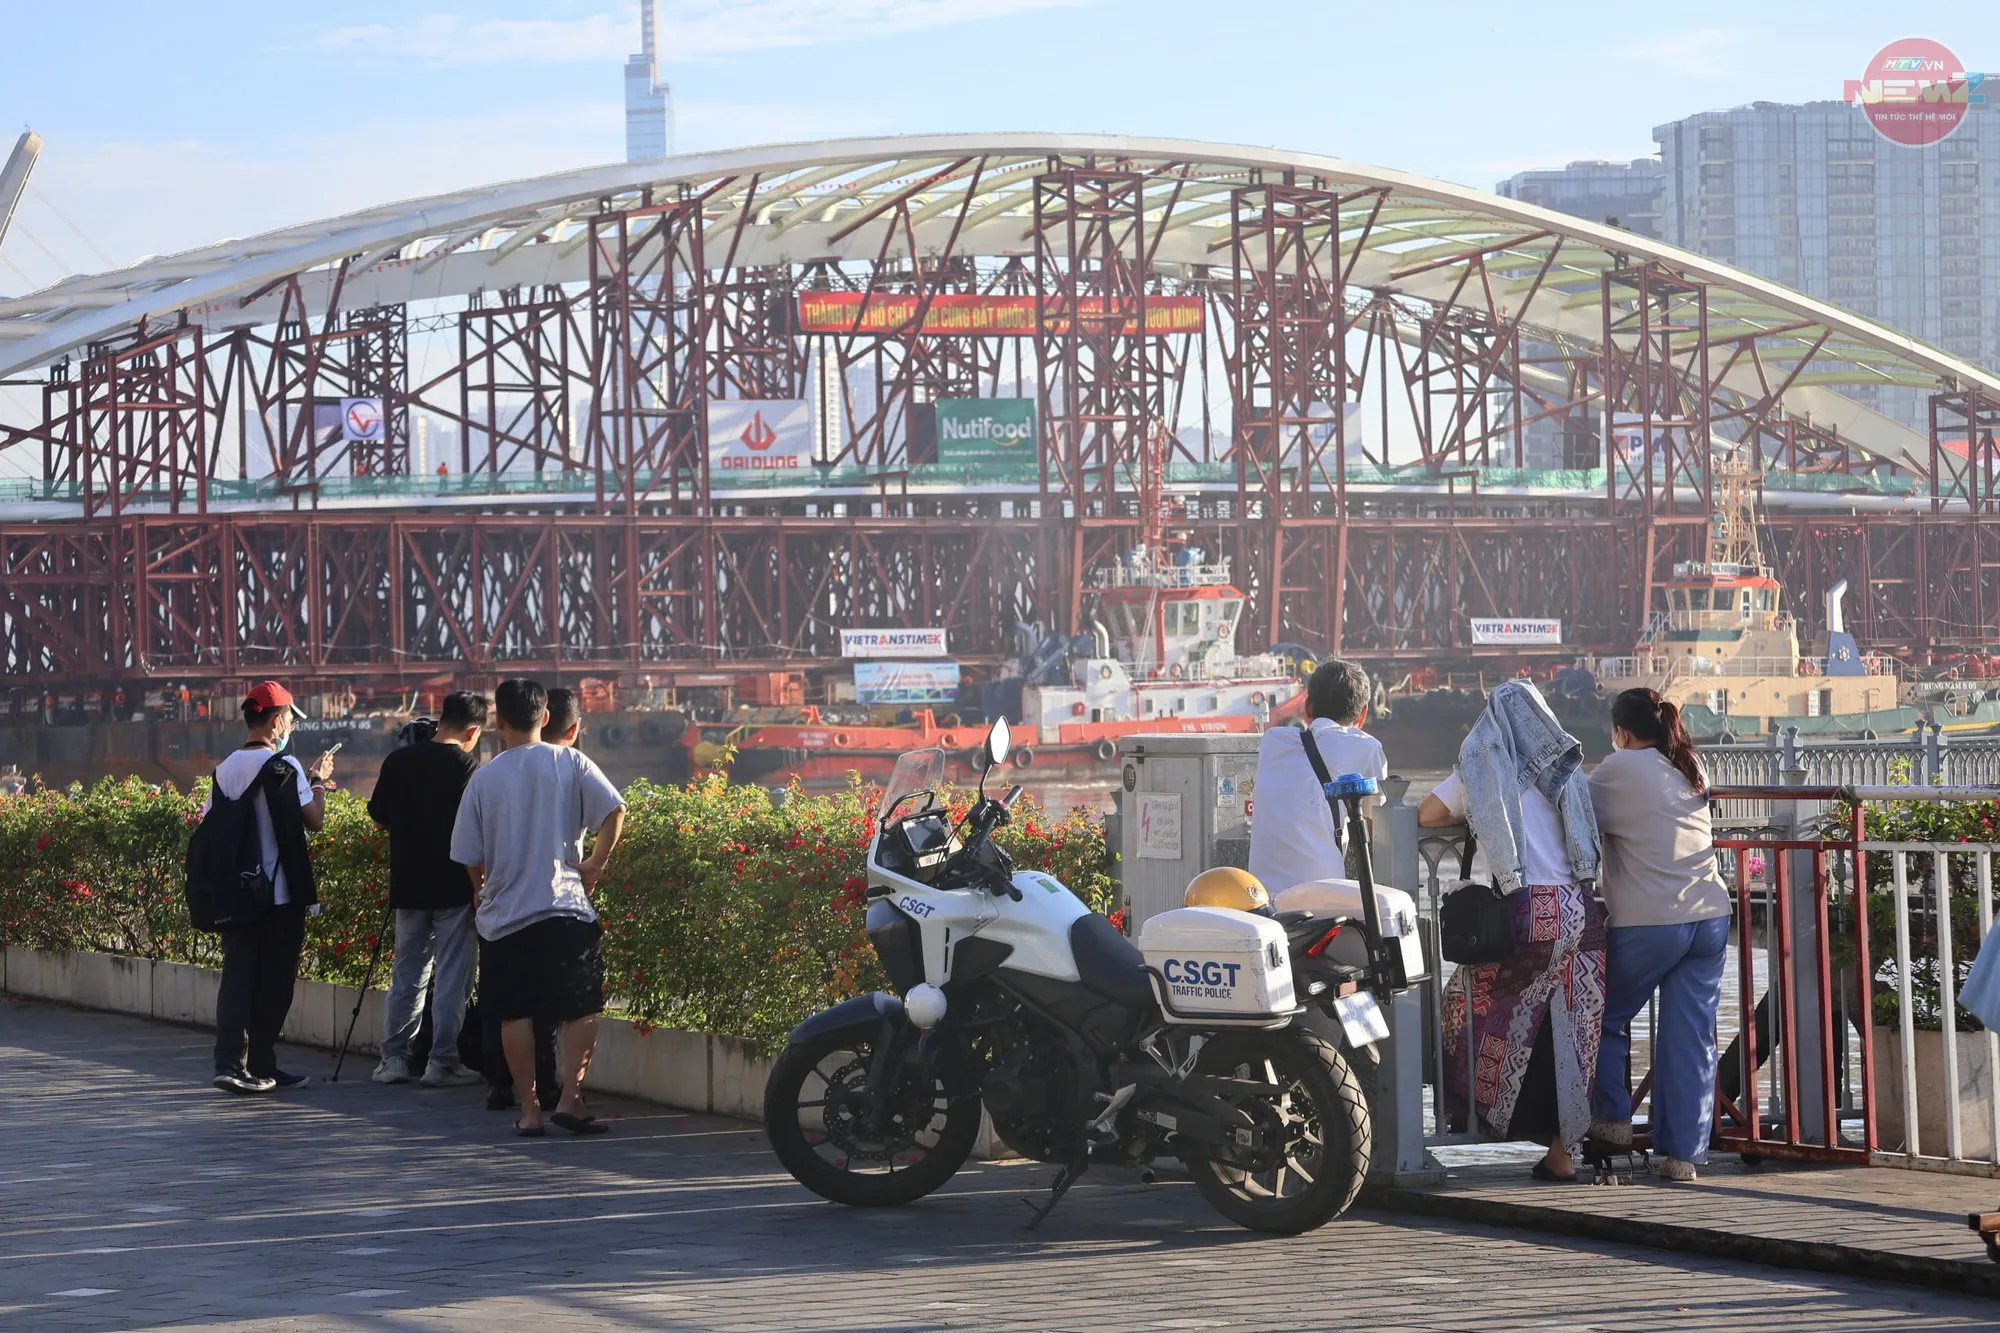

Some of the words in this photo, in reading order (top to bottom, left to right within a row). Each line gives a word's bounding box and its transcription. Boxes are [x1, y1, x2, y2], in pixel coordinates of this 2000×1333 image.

[1474, 623, 1558, 634] VIETRANSTIMEX
[844, 634, 941, 646] VIETRANSTIMEX
[1163, 958, 1241, 988] C.S.G.T
[1172, 985, 1203, 998] TRAFFIC
[1204, 987, 1232, 1000] POLICE
